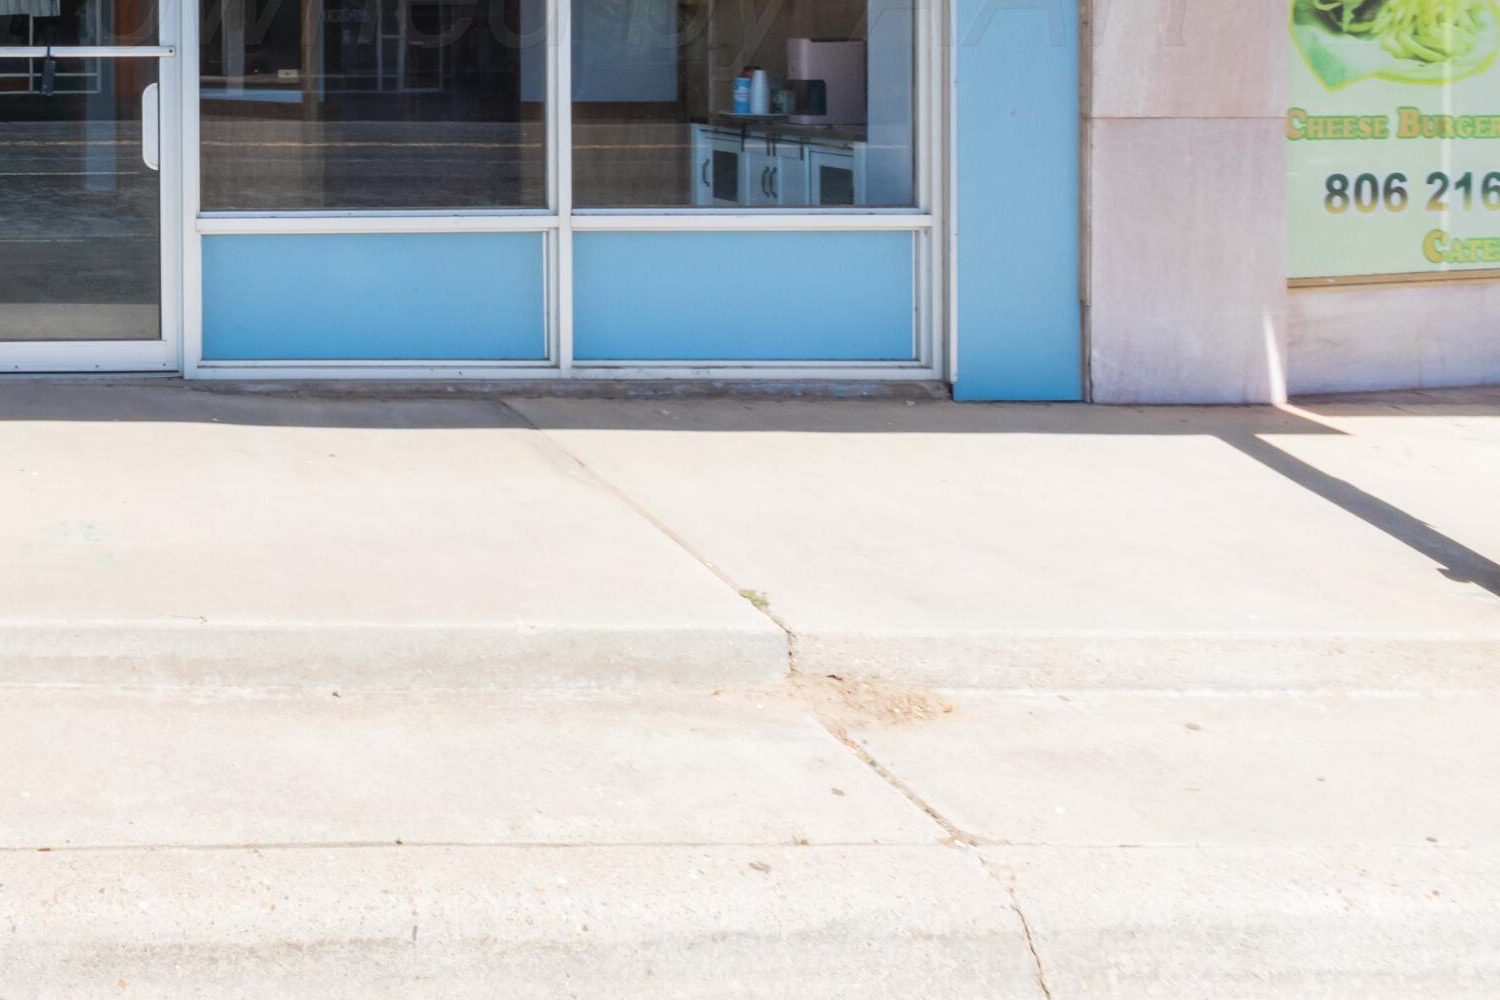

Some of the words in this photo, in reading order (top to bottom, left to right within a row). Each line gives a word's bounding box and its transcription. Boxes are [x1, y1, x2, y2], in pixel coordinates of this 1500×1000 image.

[1286, 107, 1389, 141] CHEESE
[1324, 172, 1408, 214] 806
[1425, 170, 1500, 212] 216
